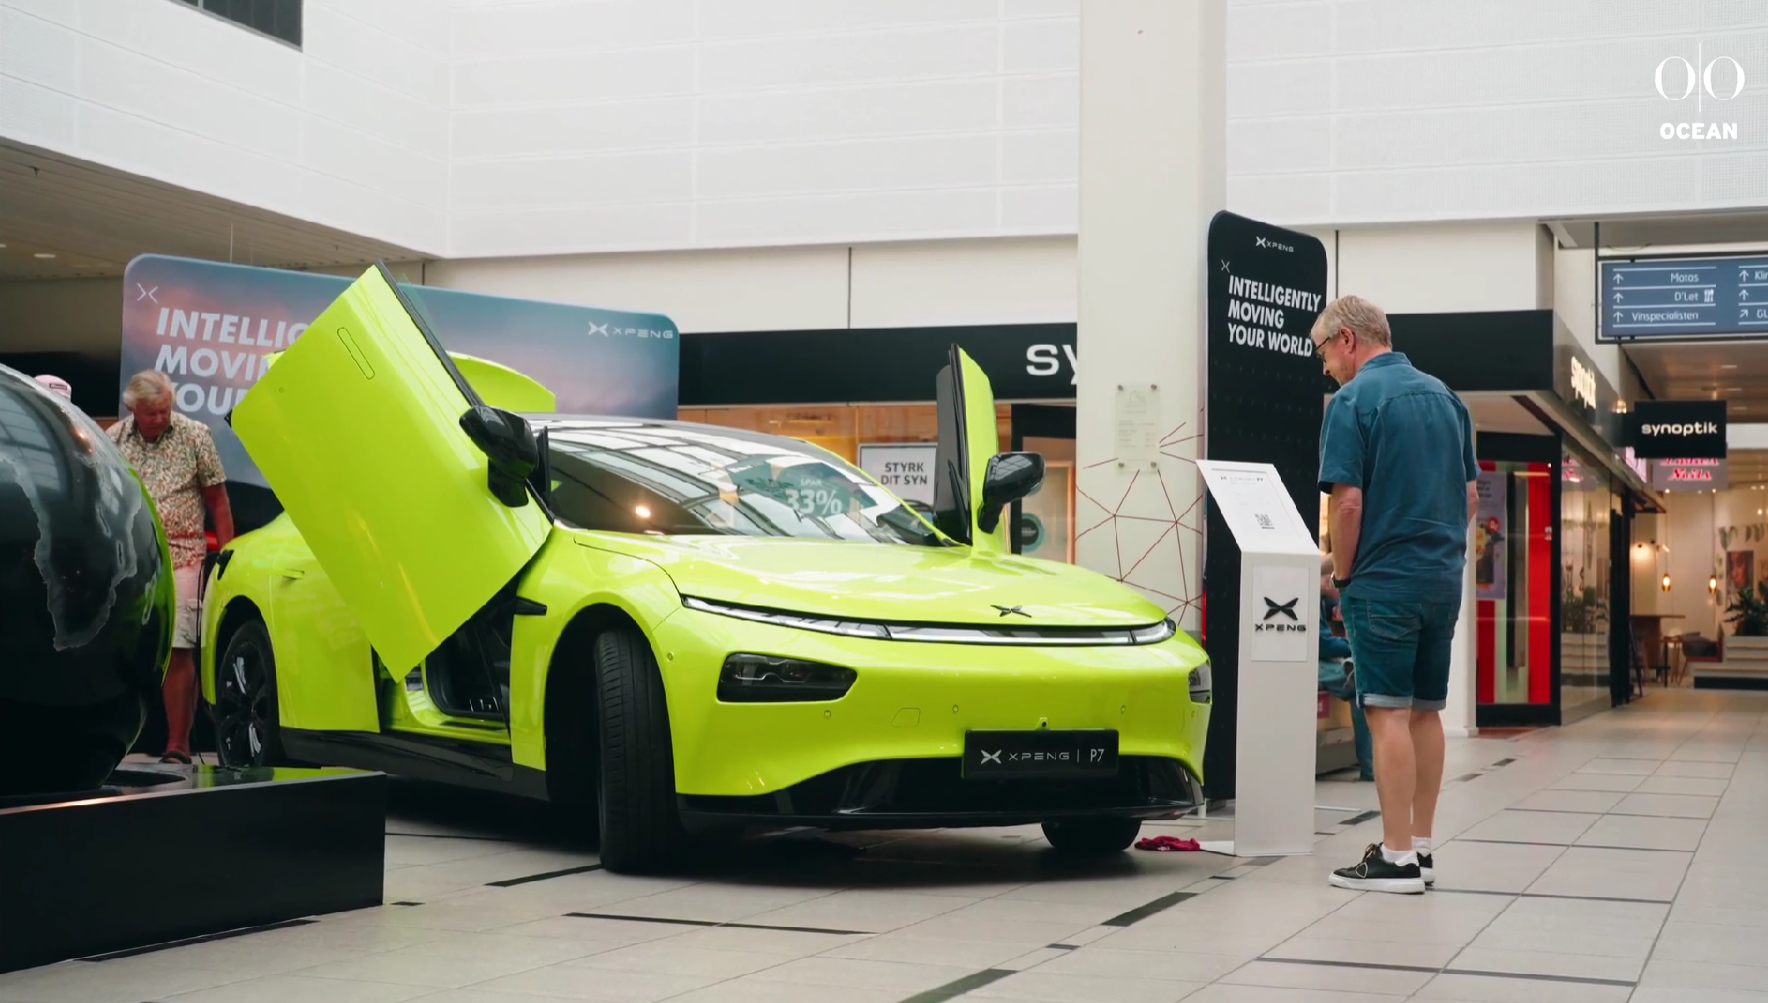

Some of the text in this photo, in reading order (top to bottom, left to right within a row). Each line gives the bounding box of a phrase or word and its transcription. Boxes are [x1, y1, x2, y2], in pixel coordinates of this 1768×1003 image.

[1266, 240, 1295, 253] XPENG
[1228, 274, 1322, 313] INTELLIGENTLY
[1227, 298, 1285, 329] MOVING
[1631, 310, 1699, 323] Vinspecialisten
[612, 326, 674, 339] XPENG
[1227, 322, 1313, 357] YOUR WORLD
[1641, 421, 1718, 437] synoptik
[884, 462, 924, 473] STYRK
[881, 474, 928, 486] DIT SYN
[785, 487, 843, 514] 33%
[1254, 623, 1307, 633] XPENG
[1008, 748, 1105, 762] XPENG P7
